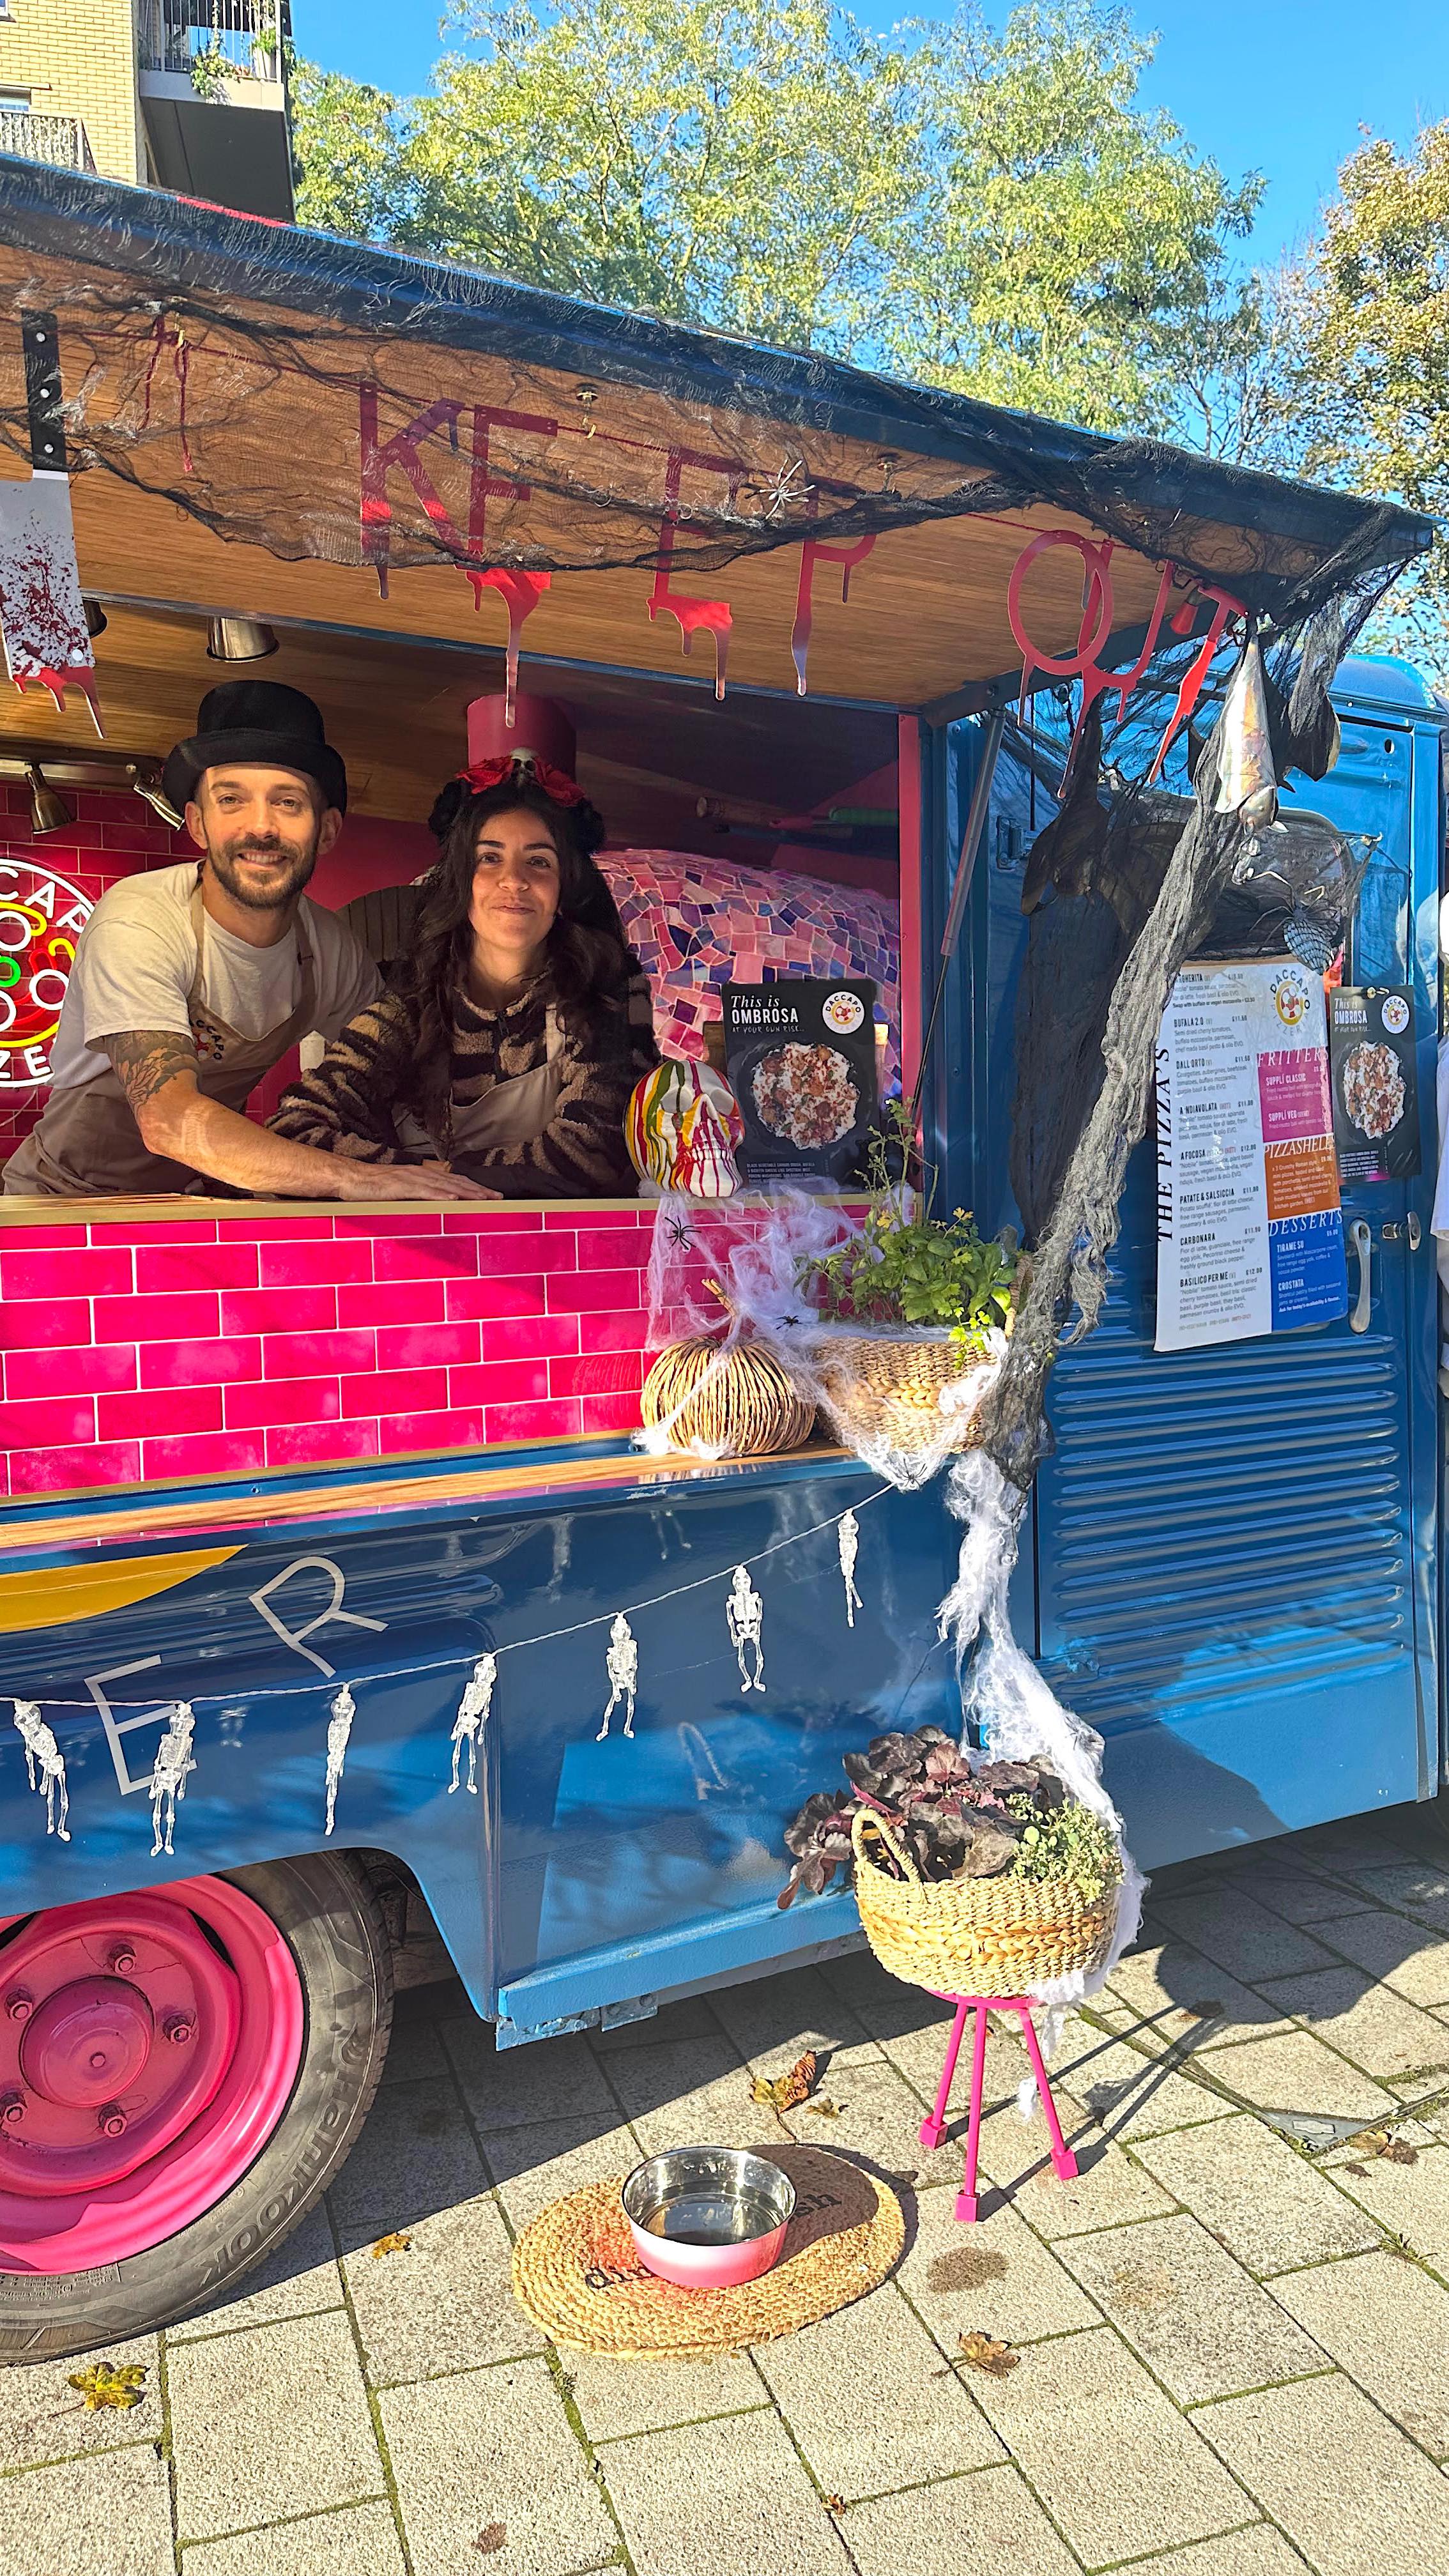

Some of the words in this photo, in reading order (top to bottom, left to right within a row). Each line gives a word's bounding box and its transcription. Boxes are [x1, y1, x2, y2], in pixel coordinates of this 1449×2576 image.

[0, 866, 91, 933] CAP
[1270, 969, 1310, 1009] DACCAPO
[731, 995, 762, 1008] This
[768, 995, 779, 1007] is
[825, 995, 861, 1012] DACCAPO
[1335, 998, 1350, 1009] This
[1352, 998, 1358, 1009] is
[732, 1008, 798, 1024] OMBROSA
[1174, 1018, 1193, 1027] BUFALA
[1335, 1010, 1367, 1024] OMBROSA
[1285, 1073, 1306, 1083] CLASSIC
[1155, 1048, 1172, 1168] PIZZA'S
[1180, 1193, 1200, 1204] PATATE
[1201, 1192, 1204, 1201] &
[1206, 1188, 1234, 1200] SALSICCIA
[1157, 1183, 1172, 1242] THE
[1269, 1210, 1342, 1237] DESSERTS
[1180, 1232, 1216, 1246] CARBONARA
[1180, 1275, 1207, 1287] BASILICO
[1208, 1273, 1219, 1282] PER
[1220, 1271, 1228, 1280] ME
